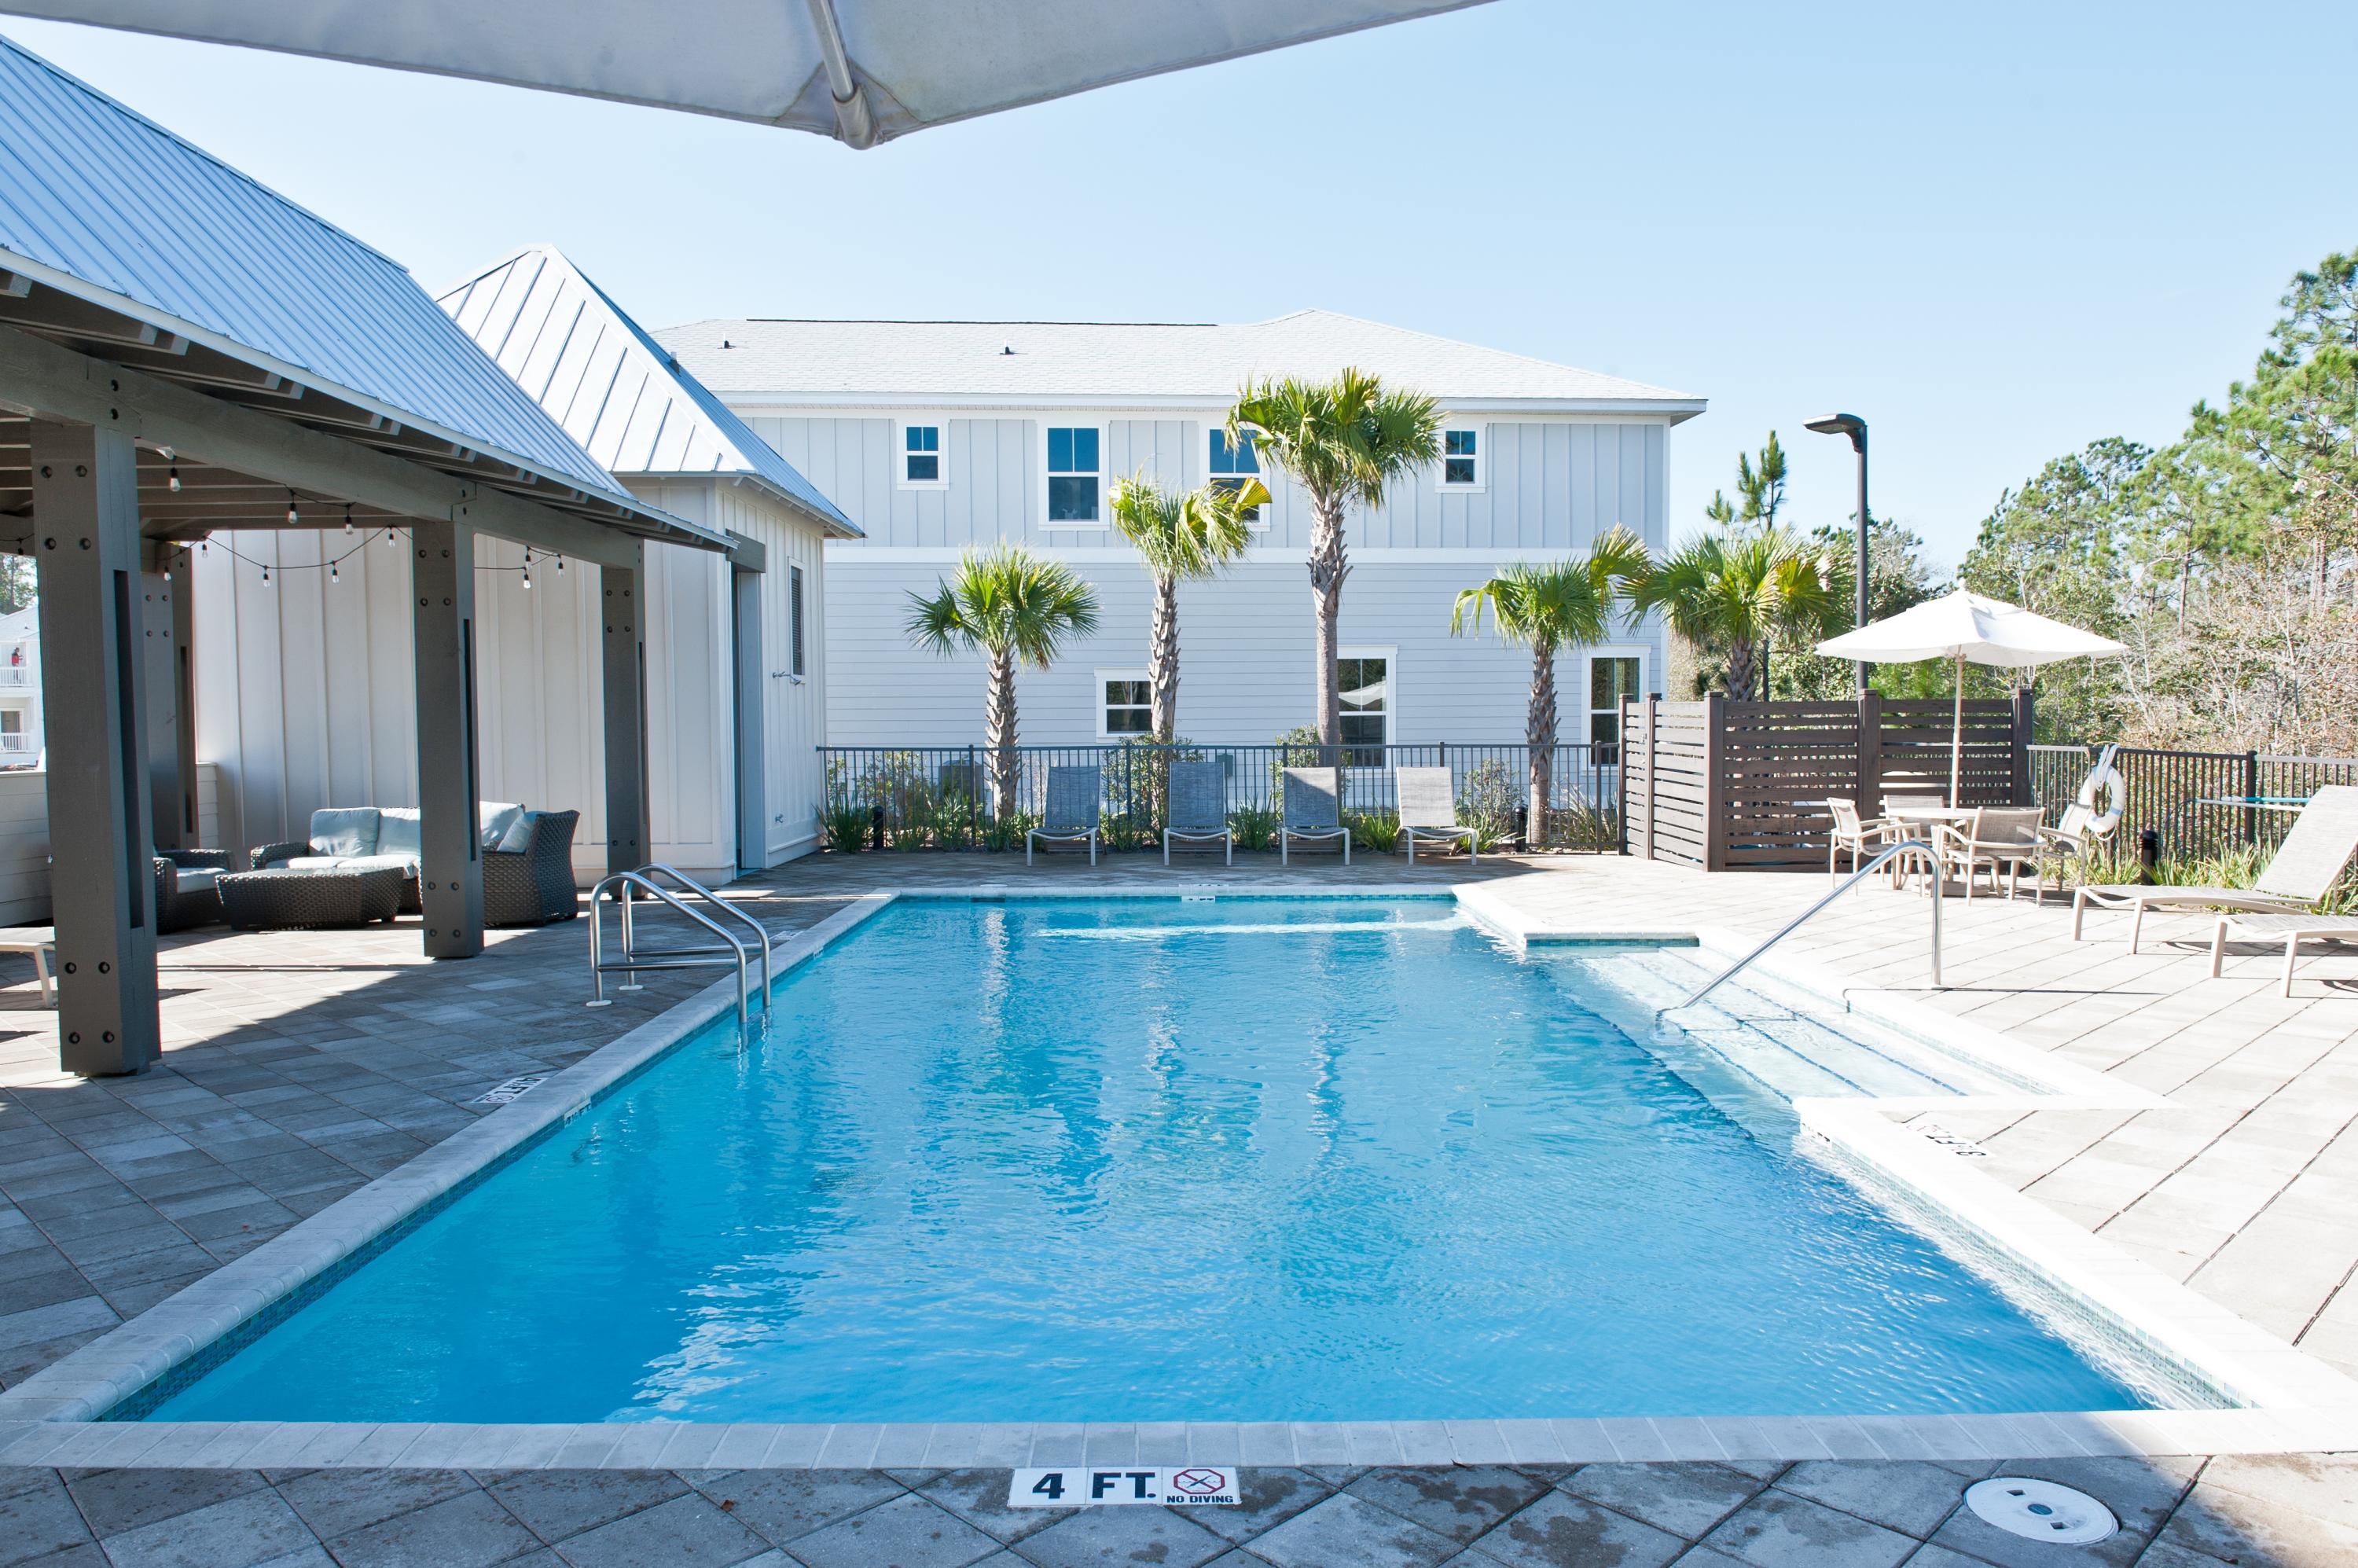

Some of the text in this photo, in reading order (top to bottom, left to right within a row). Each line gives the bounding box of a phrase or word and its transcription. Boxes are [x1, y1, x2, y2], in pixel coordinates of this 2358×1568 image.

[1032, 1472, 1156, 1500] 4 FT.
[1166, 1495, 1233, 1504] NO DIVING
